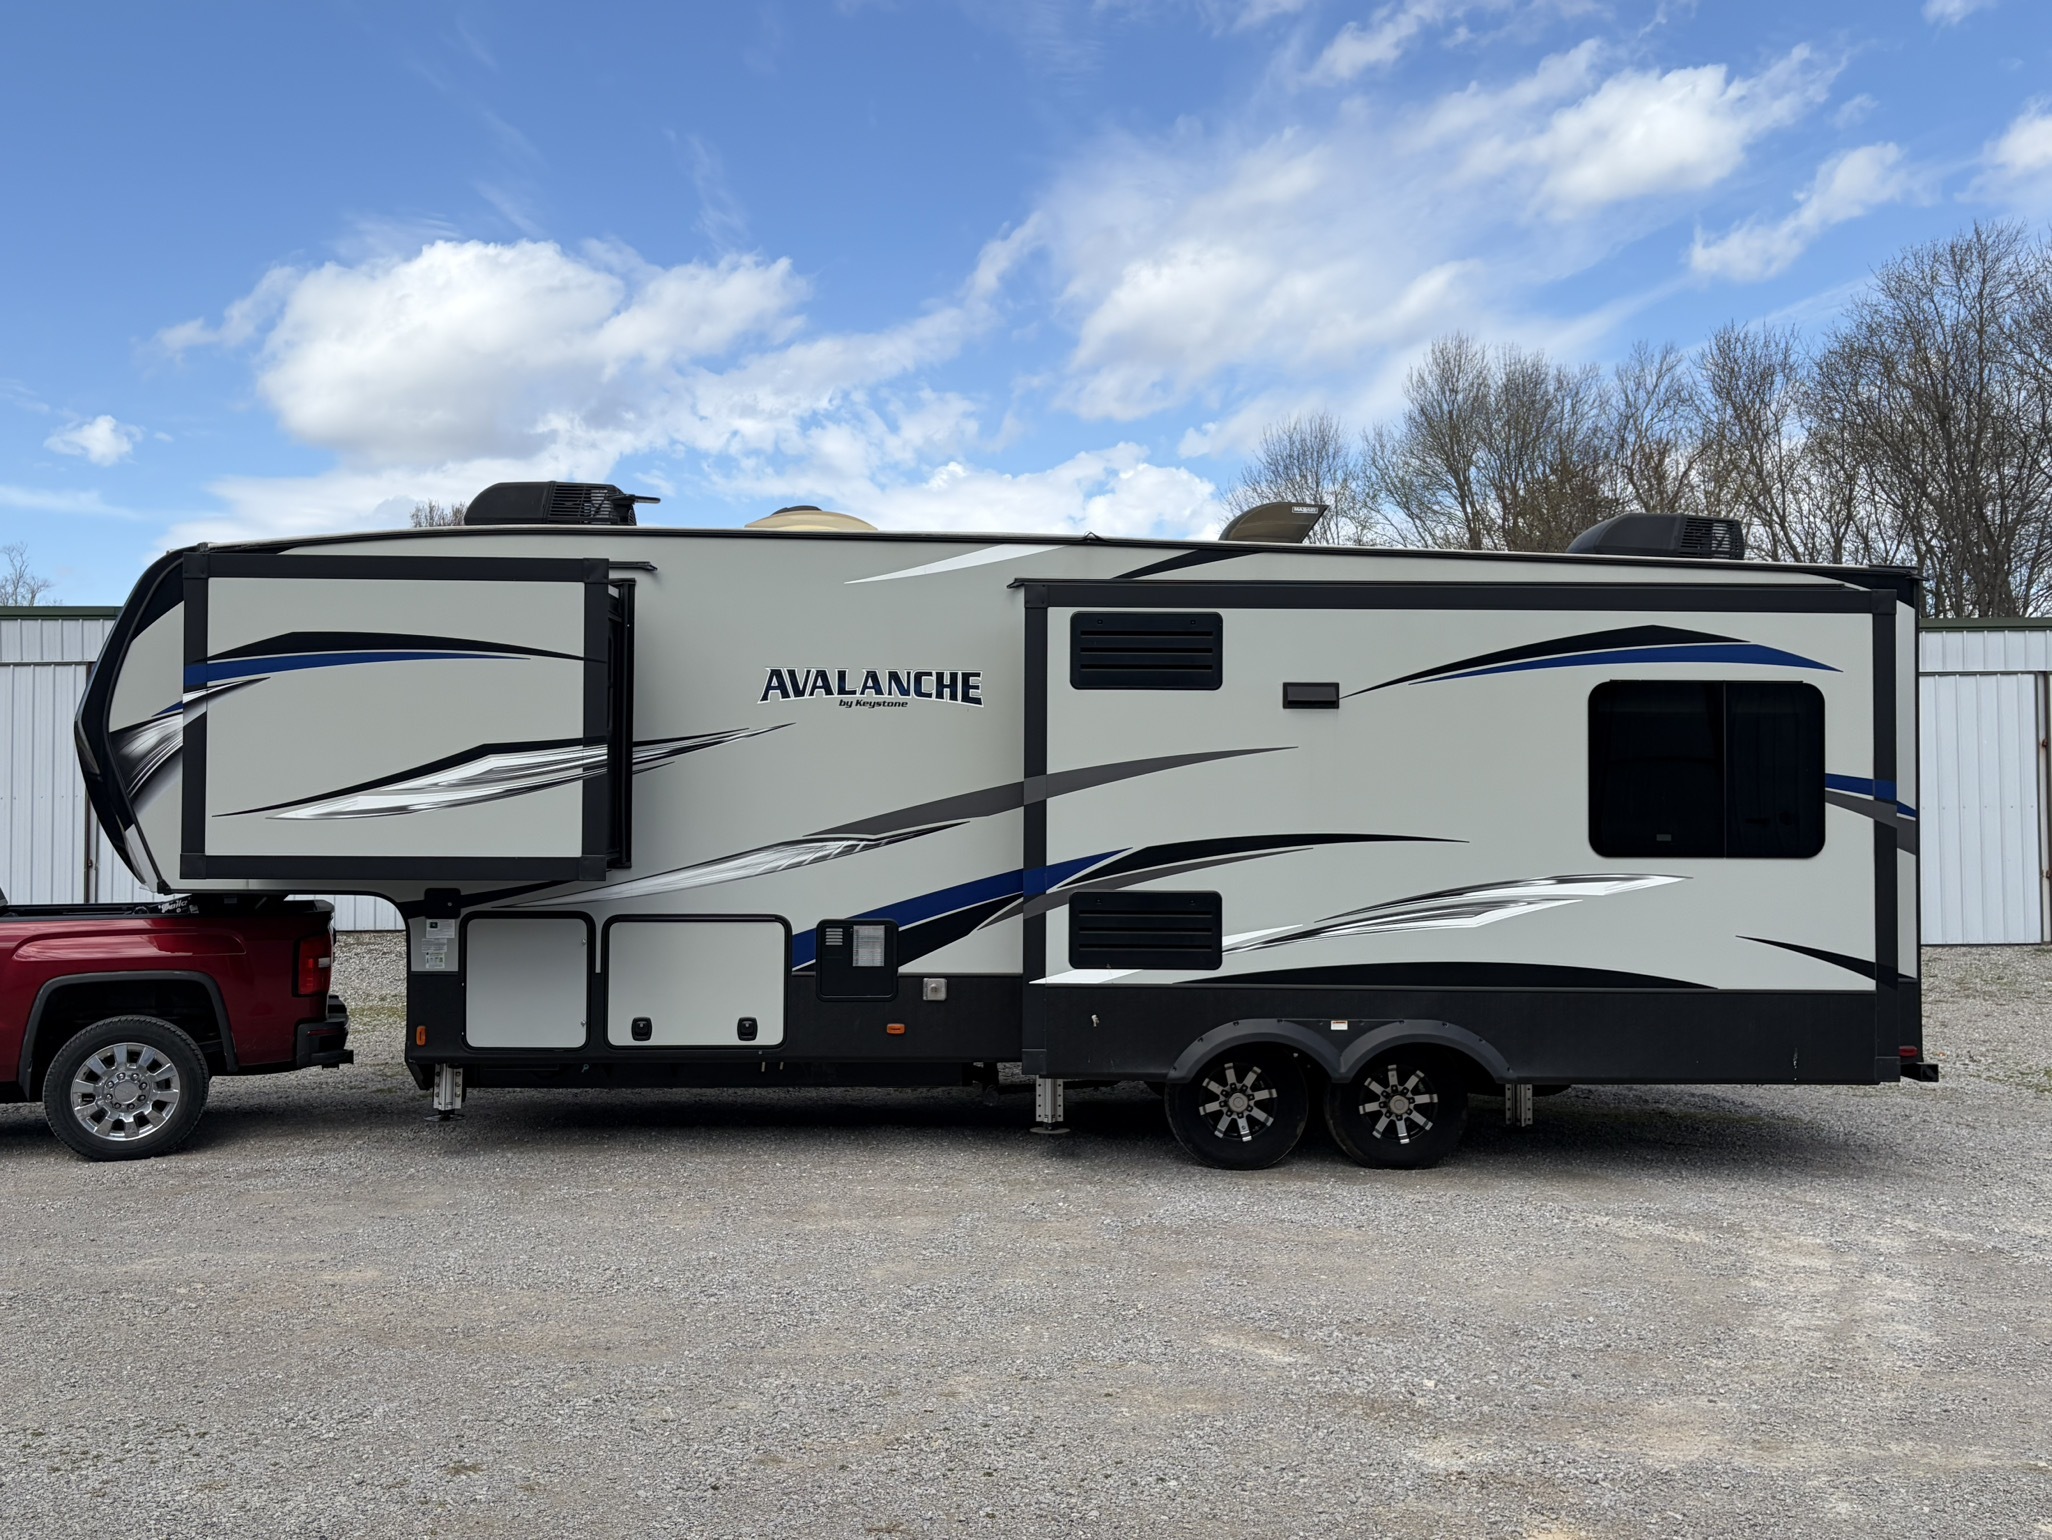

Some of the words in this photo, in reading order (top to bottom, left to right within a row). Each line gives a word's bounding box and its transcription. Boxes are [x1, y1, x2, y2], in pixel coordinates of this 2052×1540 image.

[757, 667, 984, 707] AVALANCHE
[838, 699, 853, 708] by
[855, 699, 908, 709] Keystone
